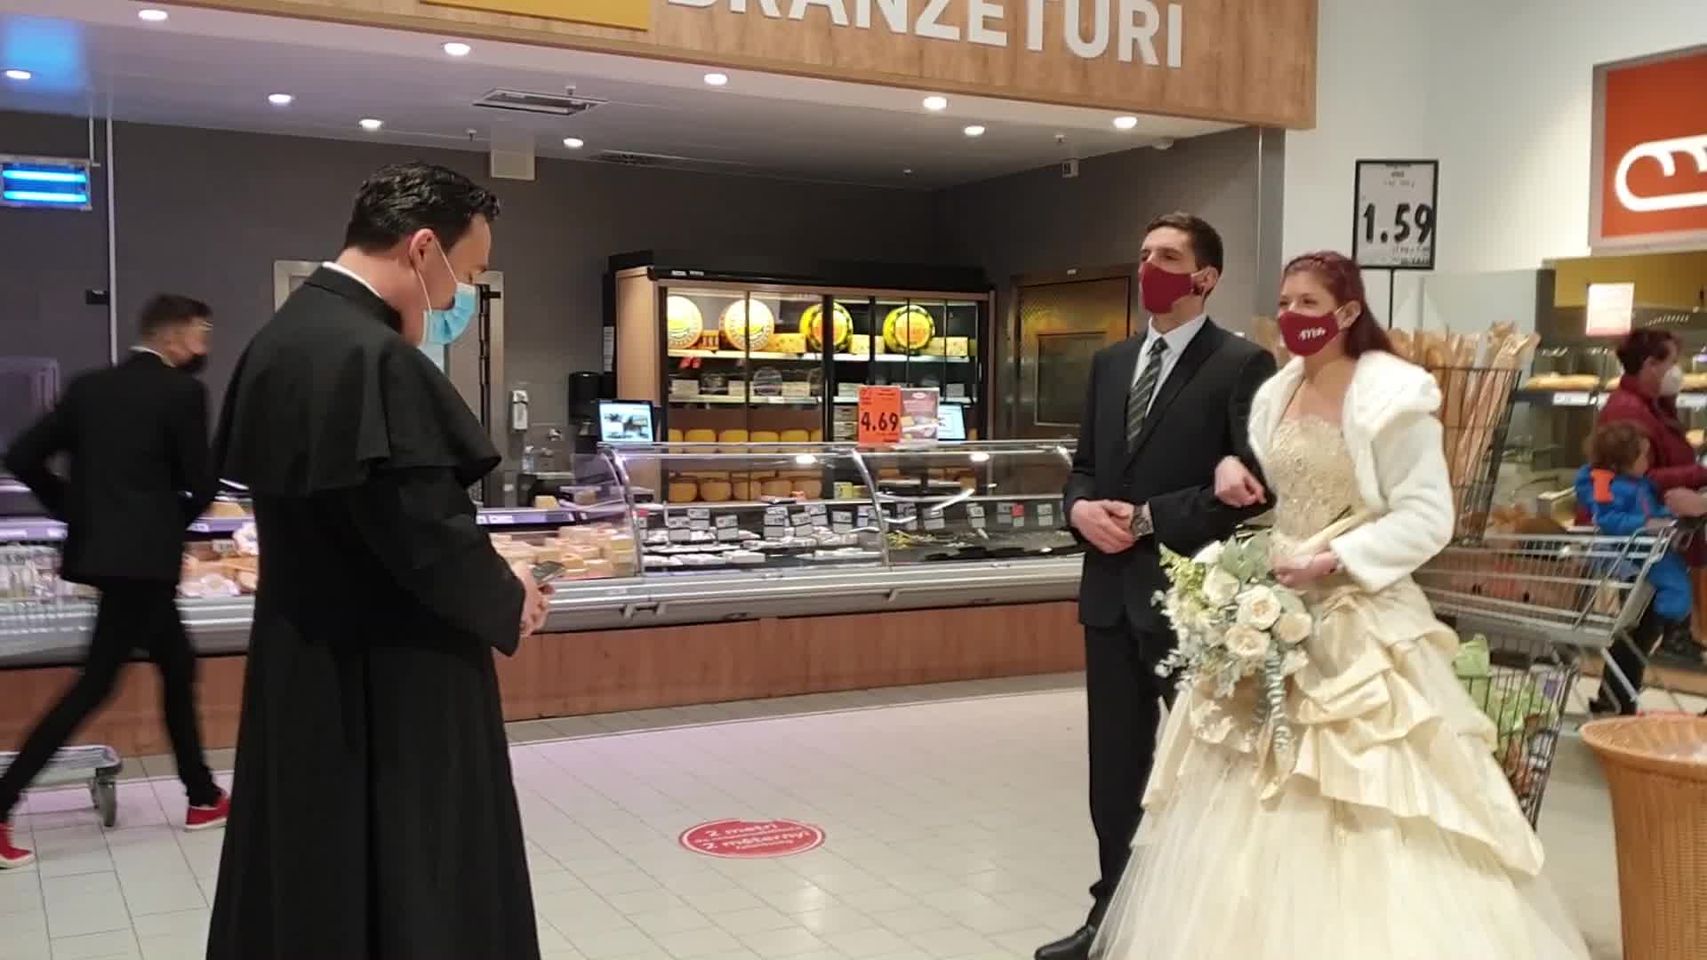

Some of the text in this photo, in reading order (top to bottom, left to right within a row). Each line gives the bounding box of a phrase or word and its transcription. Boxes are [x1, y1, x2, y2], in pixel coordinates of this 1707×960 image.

[668, 0, 1182, 68] NZETURI
[1363, 203, 1433, 244] 1.59
[861, 411, 899, 431] 4.69
